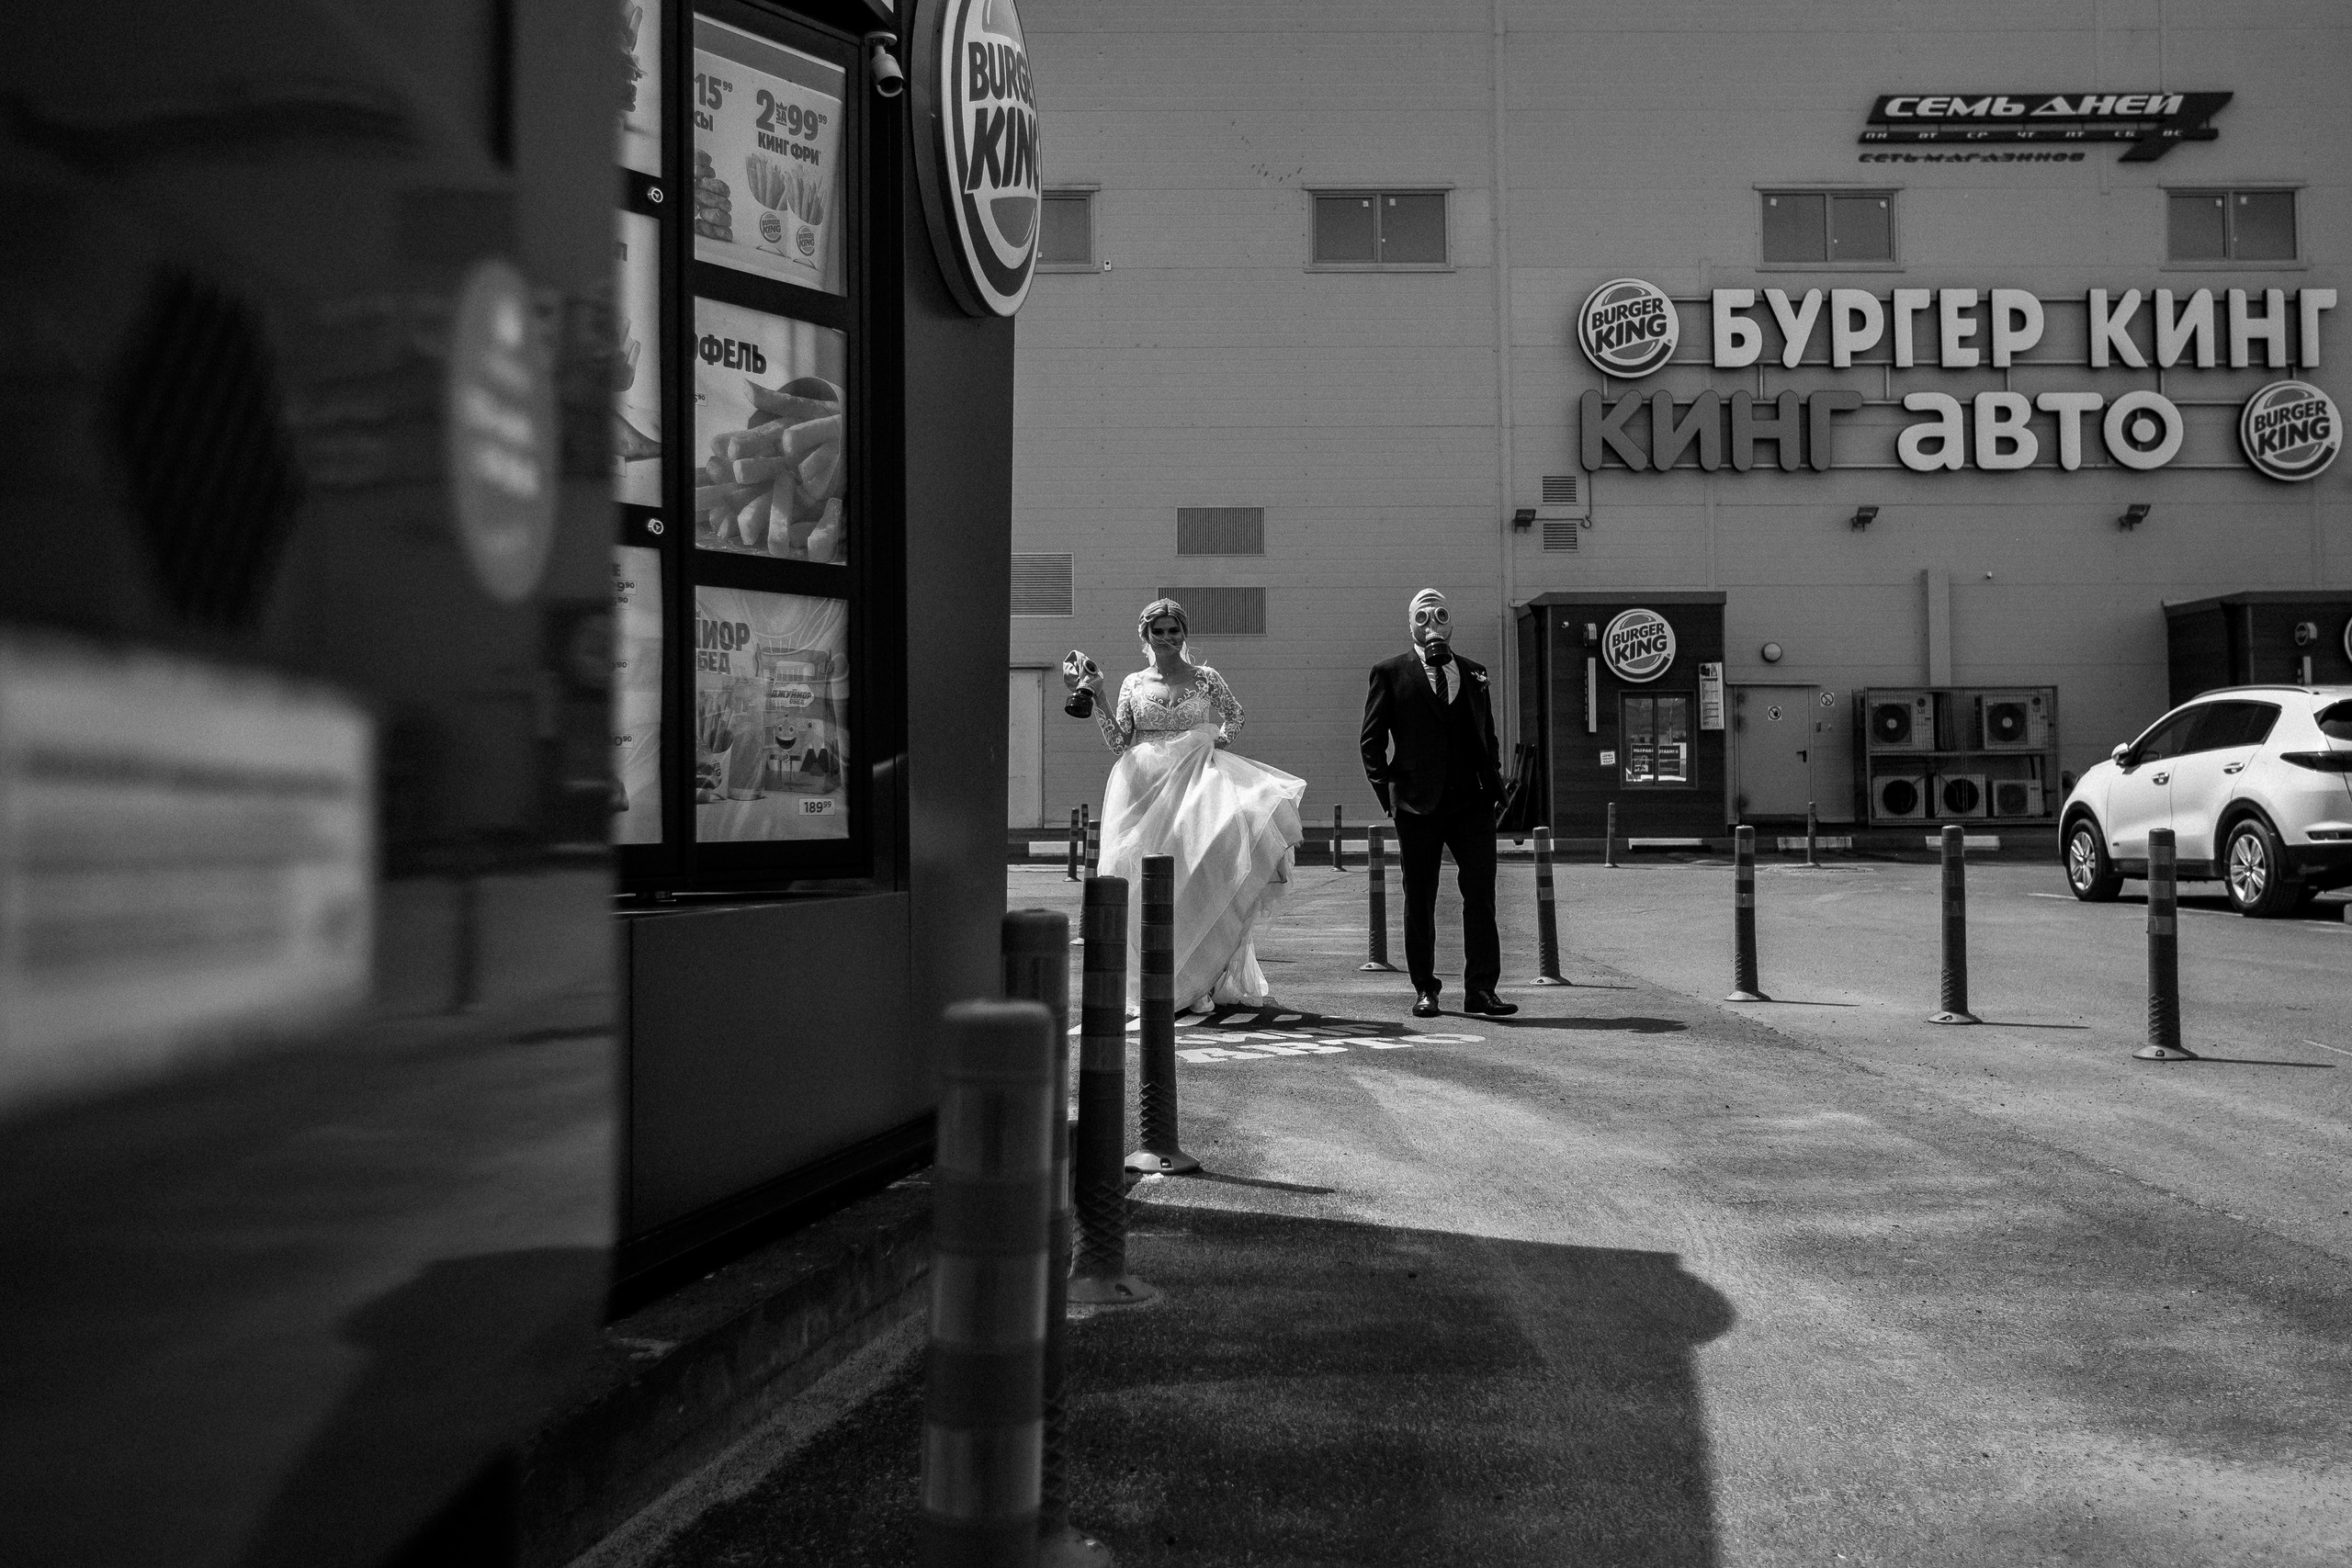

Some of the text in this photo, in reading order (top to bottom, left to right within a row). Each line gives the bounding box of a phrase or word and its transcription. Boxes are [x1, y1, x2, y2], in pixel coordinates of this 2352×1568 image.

[756, 89, 775, 133] 2
[1884, 90, 2185, 117] СЕМЬ ДНЕЙ
[758, 130, 790, 156] КИНГ
[1858, 152, 1921, 163] СЕТЬ
[763, 225, 781, 234] KING
[799, 239, 814, 247] KING
[1592, 298, 1664, 331] BURGER
[1713, 288, 2337, 367] БУРГЕР КИНГ
[1595, 313, 1667, 355] KING
[695, 333, 767, 375] ФЕЛЬ
[2254, 400, 2326, 434] BURGER
[2257, 416, 2330, 457] KING
[696, 617, 751, 651] ИОР
[1612, 623, 1665, 649] BURGER
[1614, 635, 1668, 666] KING
